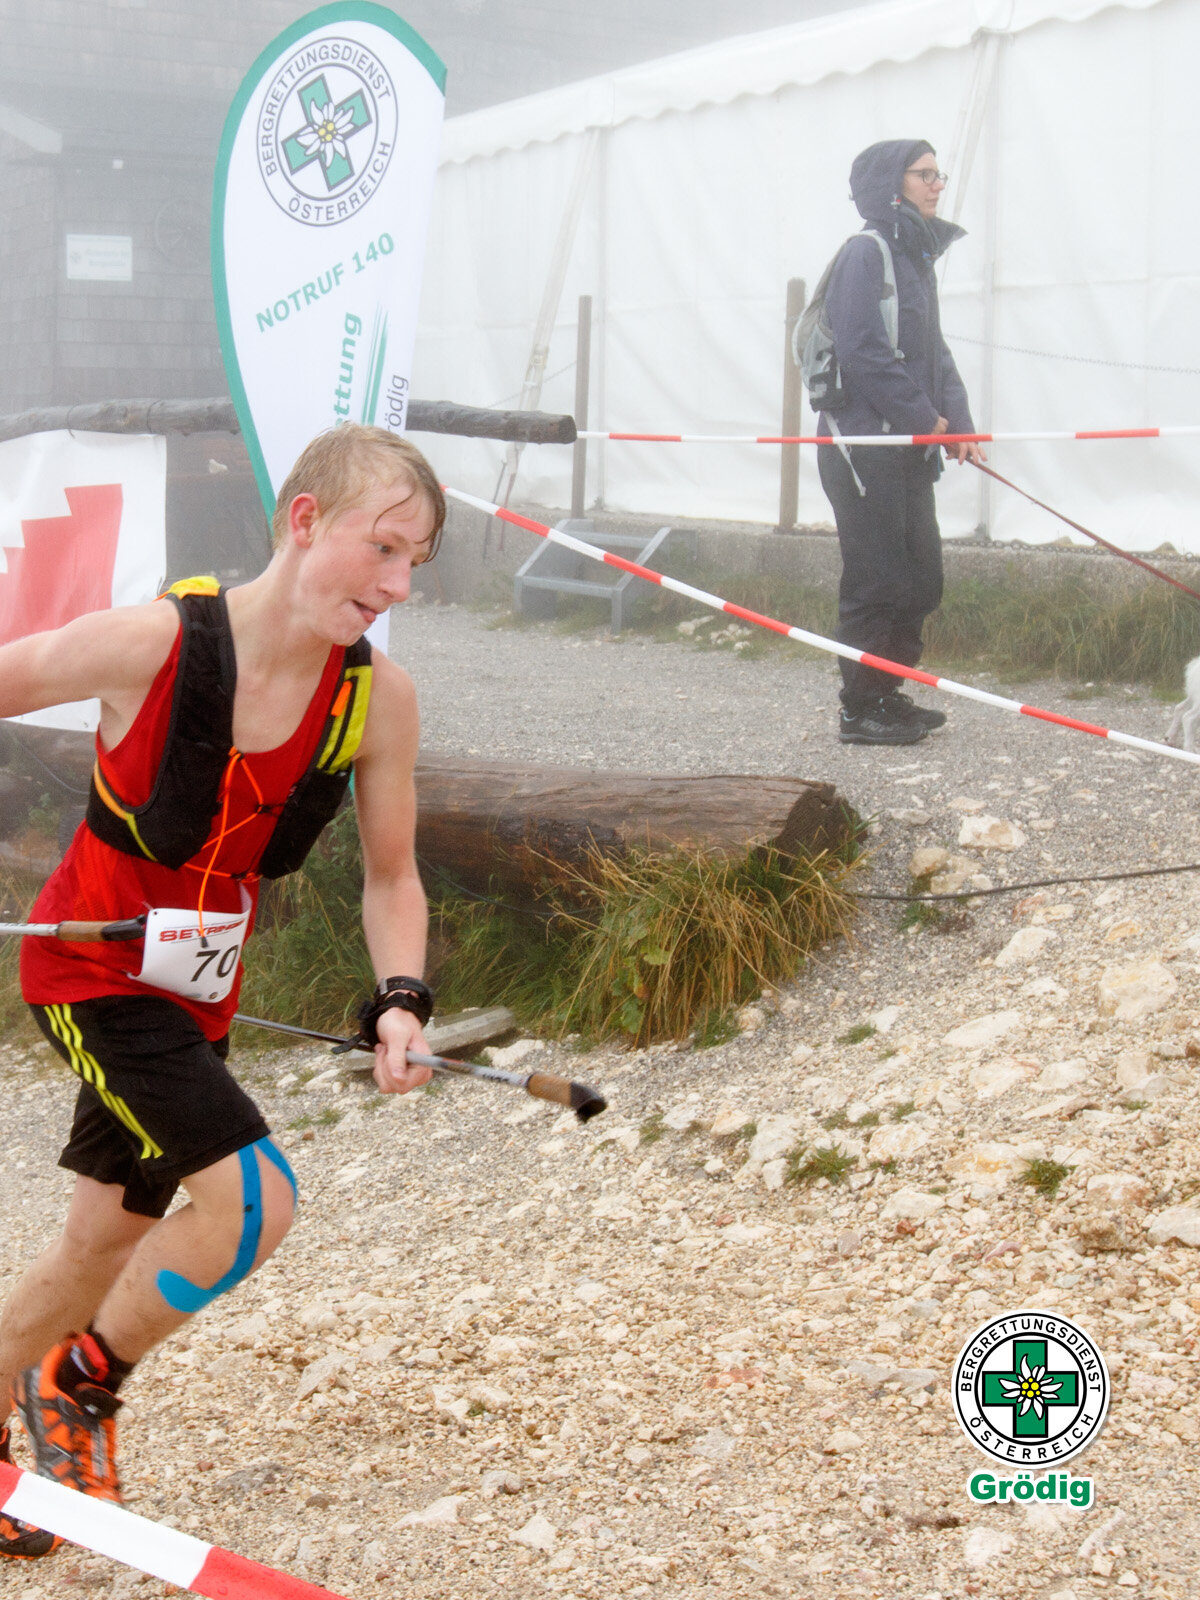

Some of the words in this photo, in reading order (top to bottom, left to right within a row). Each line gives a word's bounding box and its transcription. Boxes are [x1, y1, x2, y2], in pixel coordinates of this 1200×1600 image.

[261, 43, 392, 177] BERGRETTUNGSDIENST
[288, 141, 392, 222] ÖSTERREICH
[256, 263, 345, 333] NOTRUF
[352, 232, 395, 274] 140
[190, 944, 239, 982] 70
